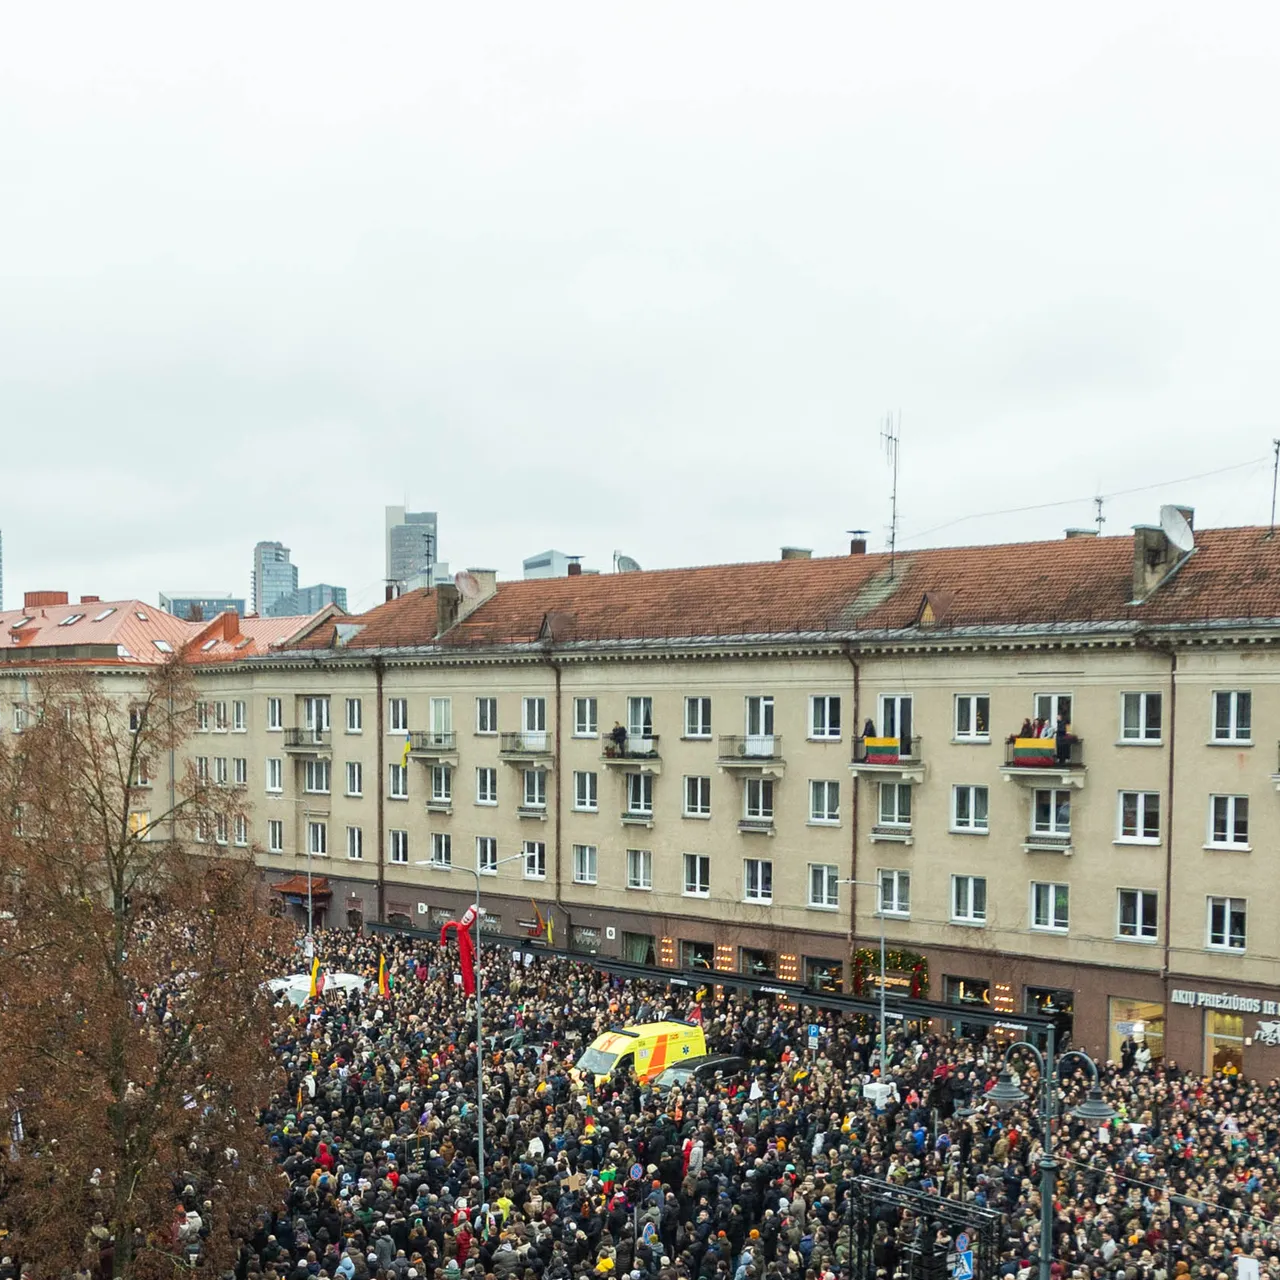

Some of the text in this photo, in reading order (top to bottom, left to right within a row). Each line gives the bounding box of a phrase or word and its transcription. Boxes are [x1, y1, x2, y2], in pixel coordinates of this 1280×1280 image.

[1171, 989, 1197, 1008] AKIŲ
[1197, 992, 1261, 1013] PRIEŽIŪROS
[1263, 1000, 1277, 1015] IR
